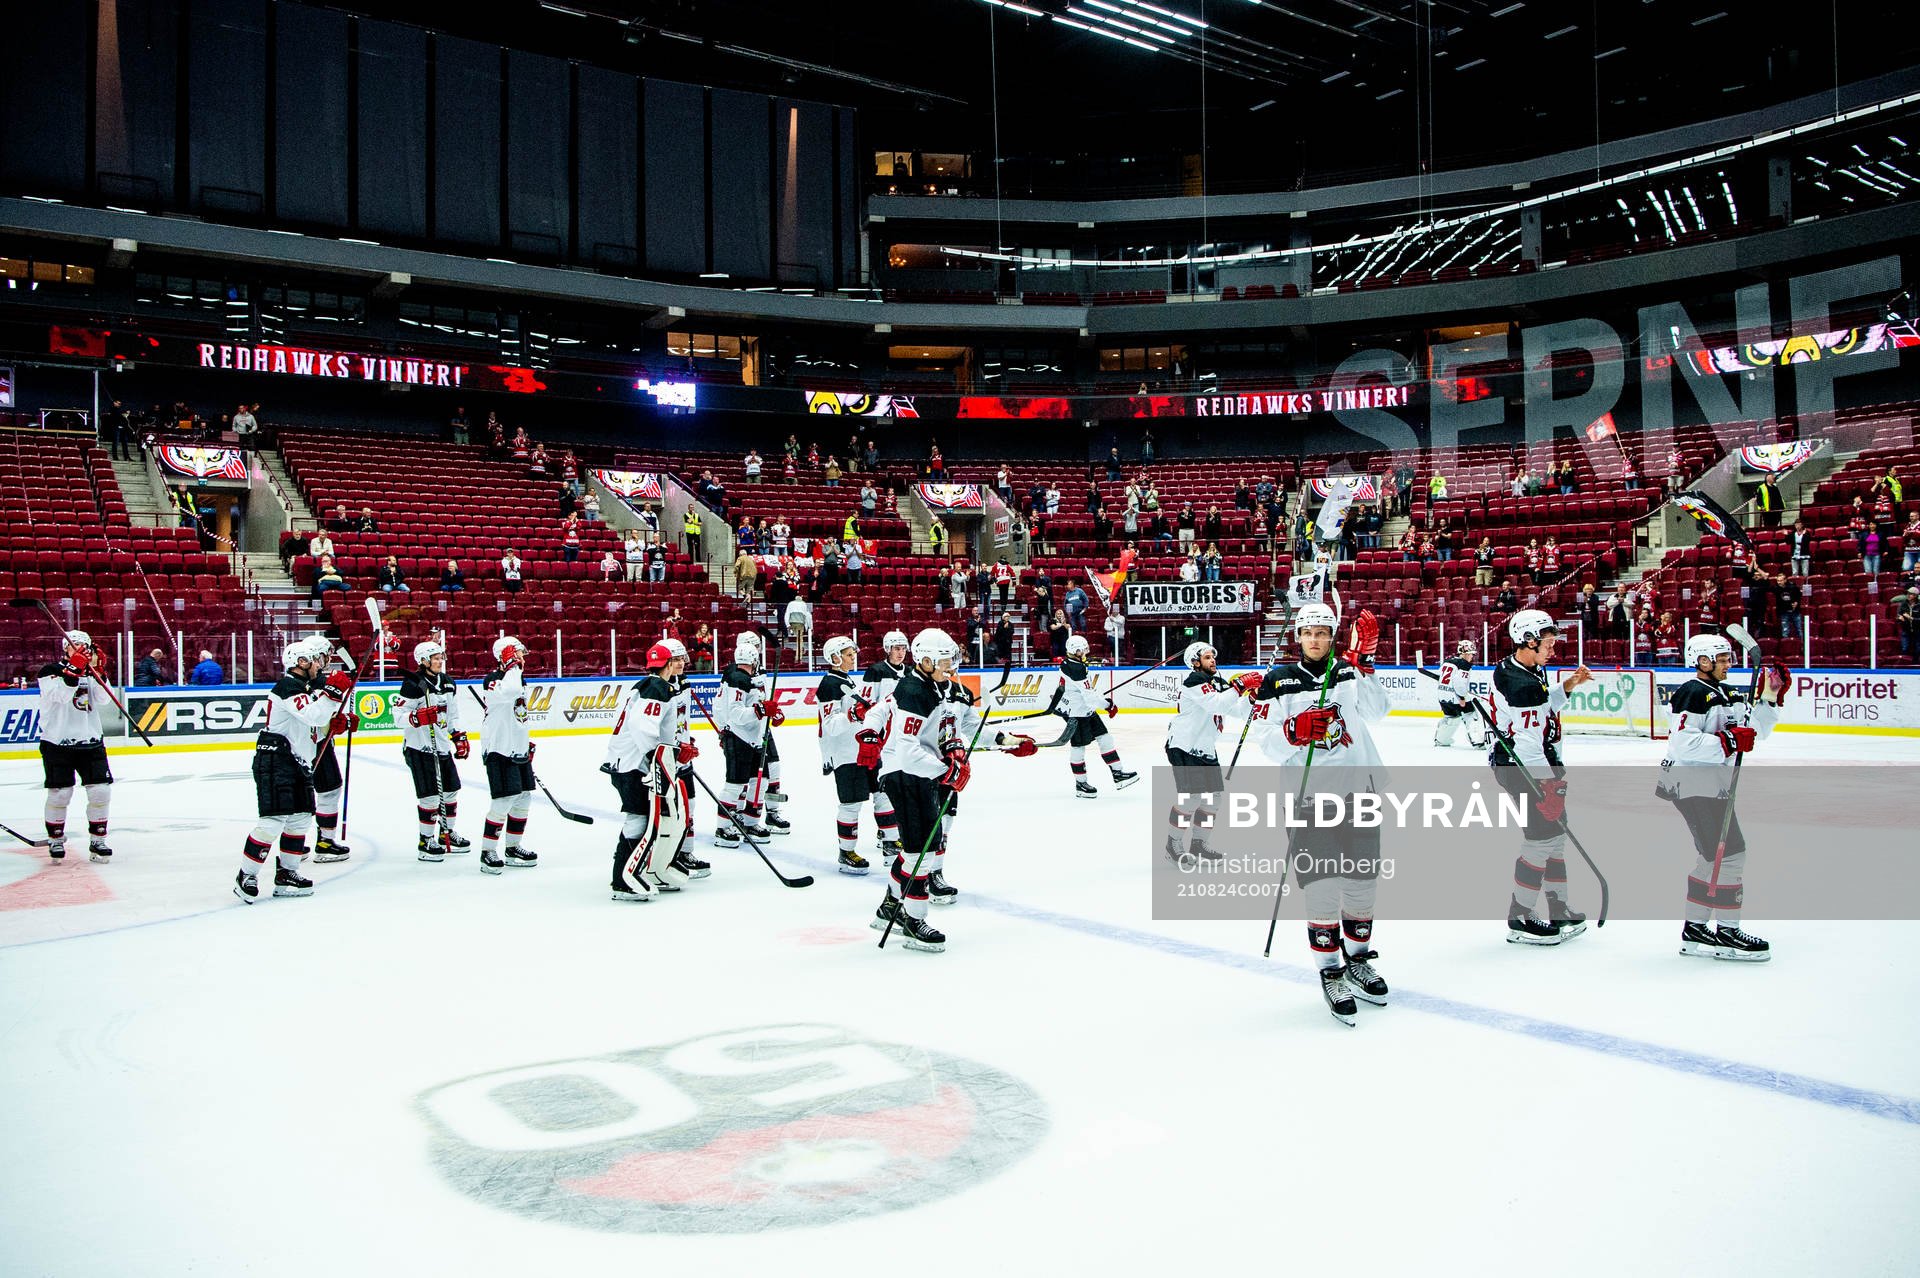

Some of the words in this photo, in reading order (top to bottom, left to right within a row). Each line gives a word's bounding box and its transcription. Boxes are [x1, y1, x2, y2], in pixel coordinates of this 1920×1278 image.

[200, 343, 350, 378] REDHAWKS
[361, 357, 462, 387] VINNER!
[1196, 394, 1313, 417] REDHAWKS
[1321, 386, 1408, 411] VINNER!
[1128, 584, 1237, 606] FAUTORES
[861, 686, 872, 698] 14
[995, 674, 1043, 706] guld
[1797, 677, 1898, 699] Prioritet
[293, 694, 310, 711] 27
[563, 684, 622, 723] guld
[644, 702, 662, 717] 48
[1252, 703, 1271, 720] 24
[1814, 698, 1879, 720] Finans
[167, 700, 268, 731] RSA
[579, 712, 614, 720] KANALEN
[627, 837, 648, 874] CCM
